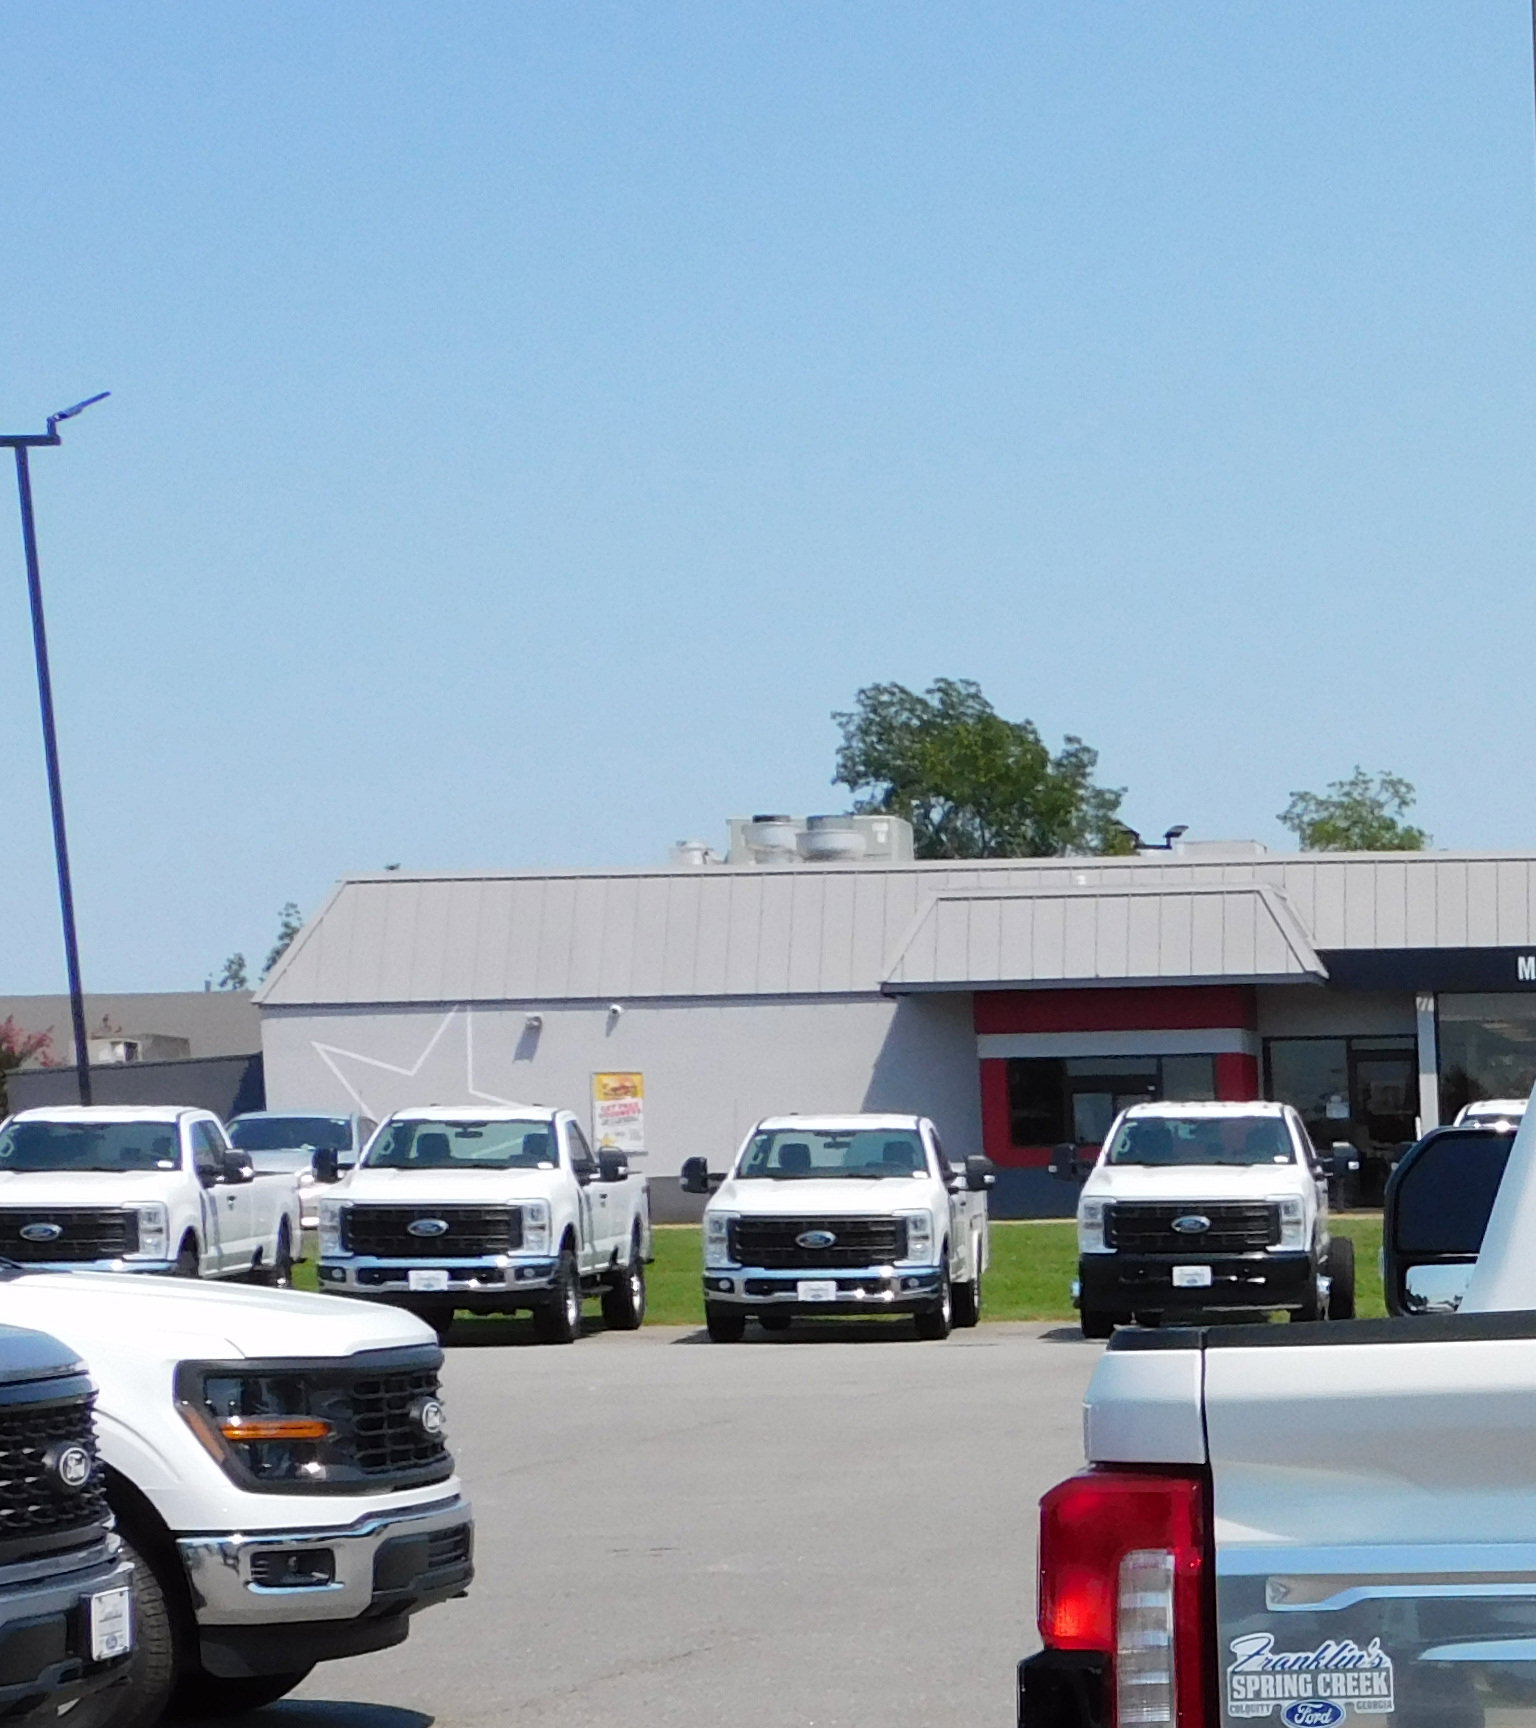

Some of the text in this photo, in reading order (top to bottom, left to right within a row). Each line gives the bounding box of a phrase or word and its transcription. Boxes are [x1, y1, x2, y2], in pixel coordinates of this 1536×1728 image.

[1230, 1634, 1384, 1674] Franklin's
[1232, 1671, 1389, 1699] SPRING CREEK
[1293, 1702, 1333, 1725] Ford
